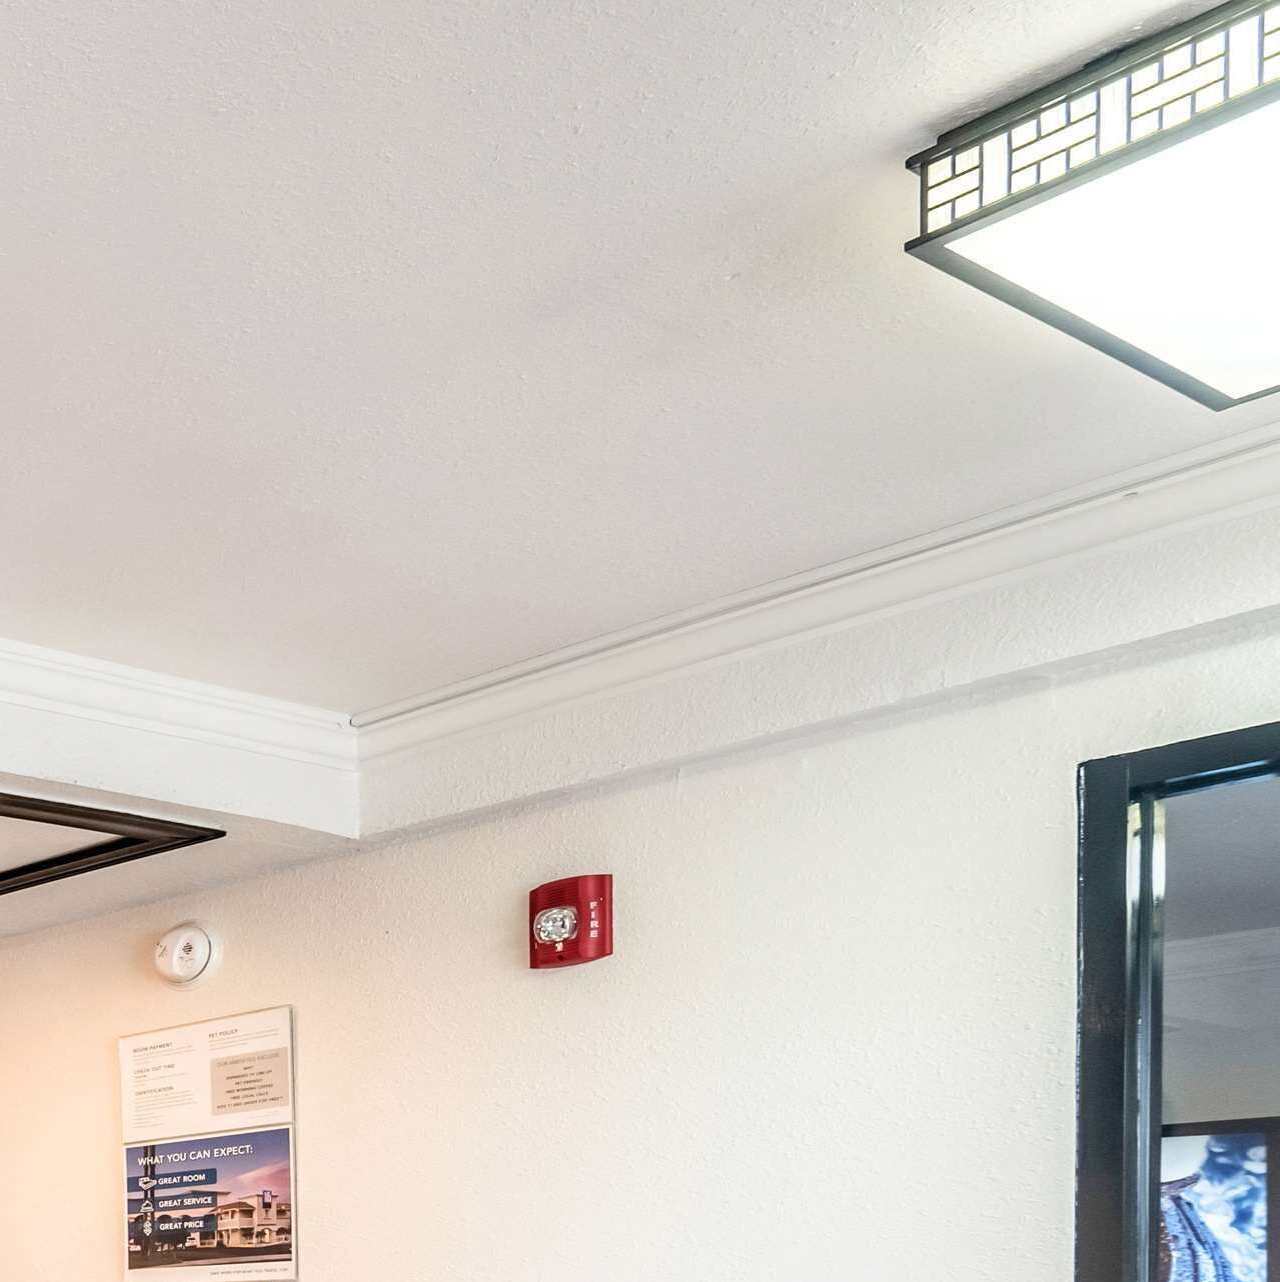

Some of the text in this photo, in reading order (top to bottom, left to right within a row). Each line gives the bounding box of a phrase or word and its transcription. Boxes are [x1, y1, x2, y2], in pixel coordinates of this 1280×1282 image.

[590, 901, 599, 938] FIRE
[138, 1144, 253, 1166] WHAT YOU CAN EXPECT:
[158, 1174, 206, 1185] GREAT ROOM
[159, 1196, 212, 1208] GREAT SERVICE
[159, 1221, 204, 1231] GREAT PRICE
